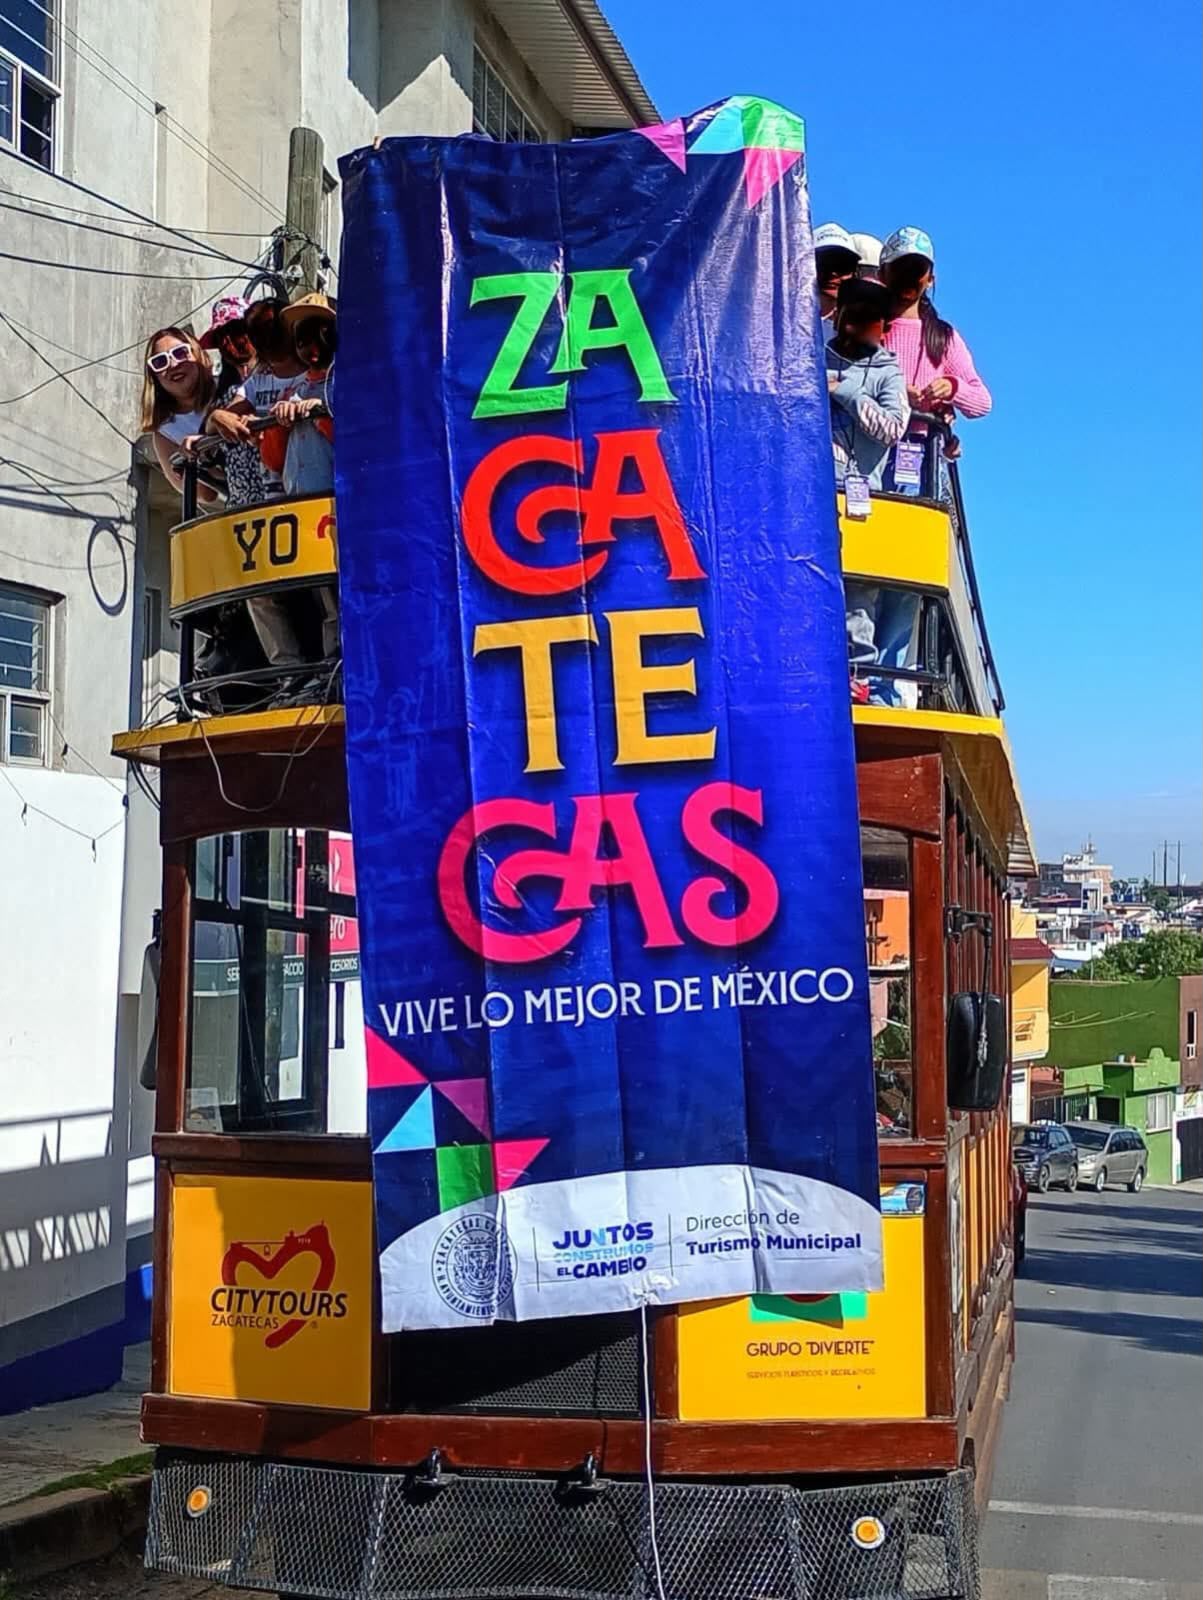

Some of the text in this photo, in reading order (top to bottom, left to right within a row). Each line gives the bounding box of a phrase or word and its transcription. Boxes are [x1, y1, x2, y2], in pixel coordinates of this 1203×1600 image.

[470, 269, 675, 419] ZA
[461, 428, 706, 597] CA
[233, 513, 299, 572] YO
[474, 607, 717, 775] TE
[437, 783, 779, 964] CAS
[378, 965, 854, 1037] VIVE LO MEJOR DE MÉXICO
[552, 1221, 654, 1250] JUNTOS
[686, 1209, 800, 1232] Dirección de
[685, 1232, 862, 1256] Turismo Municipal
[557, 1256, 647, 1279] EL CAMBIO
[211, 1287, 348, 1318] CITYTOURS
[211, 1314, 279, 1329] ZACATECAS
[746, 1341, 802, 1357] GRUPO
